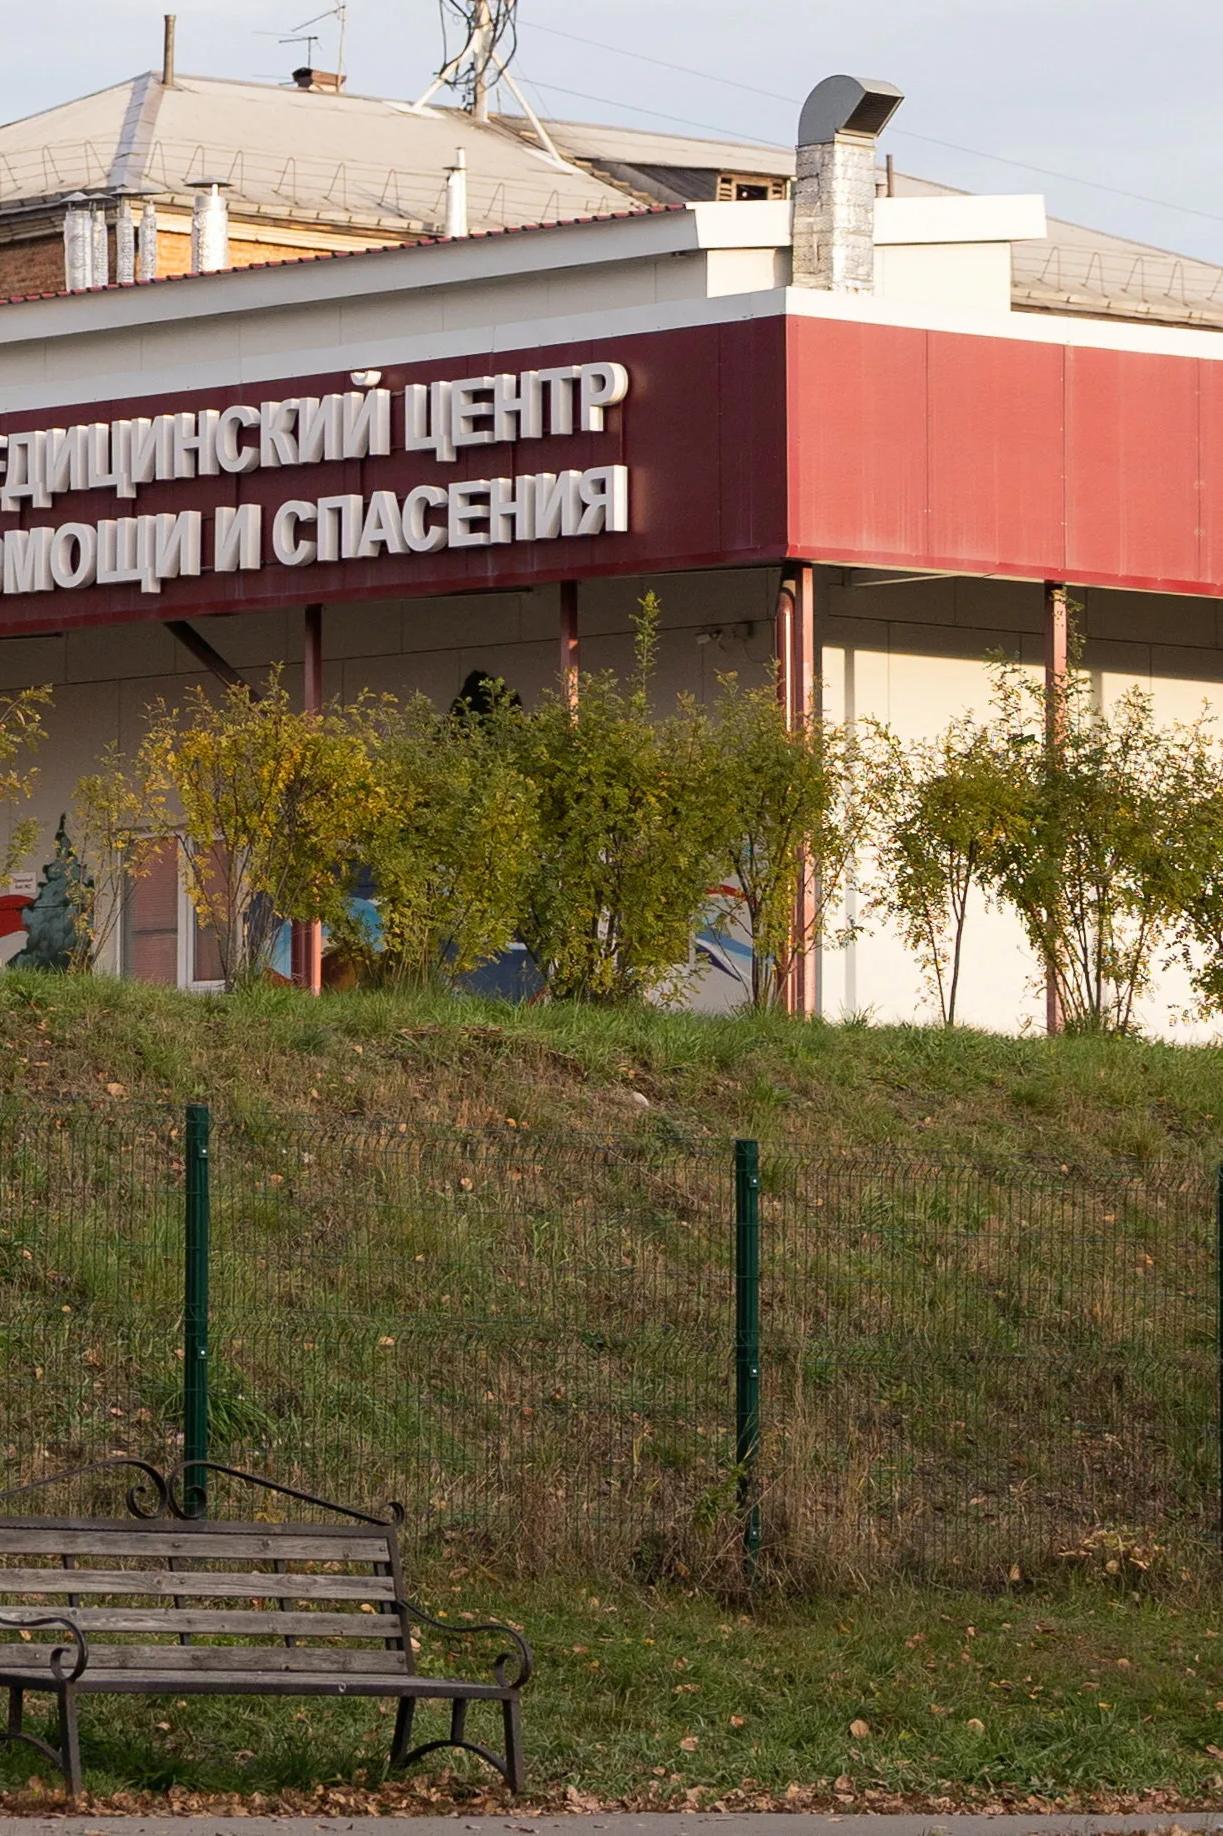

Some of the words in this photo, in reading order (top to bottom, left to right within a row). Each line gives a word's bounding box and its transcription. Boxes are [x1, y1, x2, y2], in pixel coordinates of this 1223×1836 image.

[405, 361, 629, 463] ЦЕНТР
[213, 502, 263, 574] И
[271, 464, 629, 568] СПАСЕНИЯ
